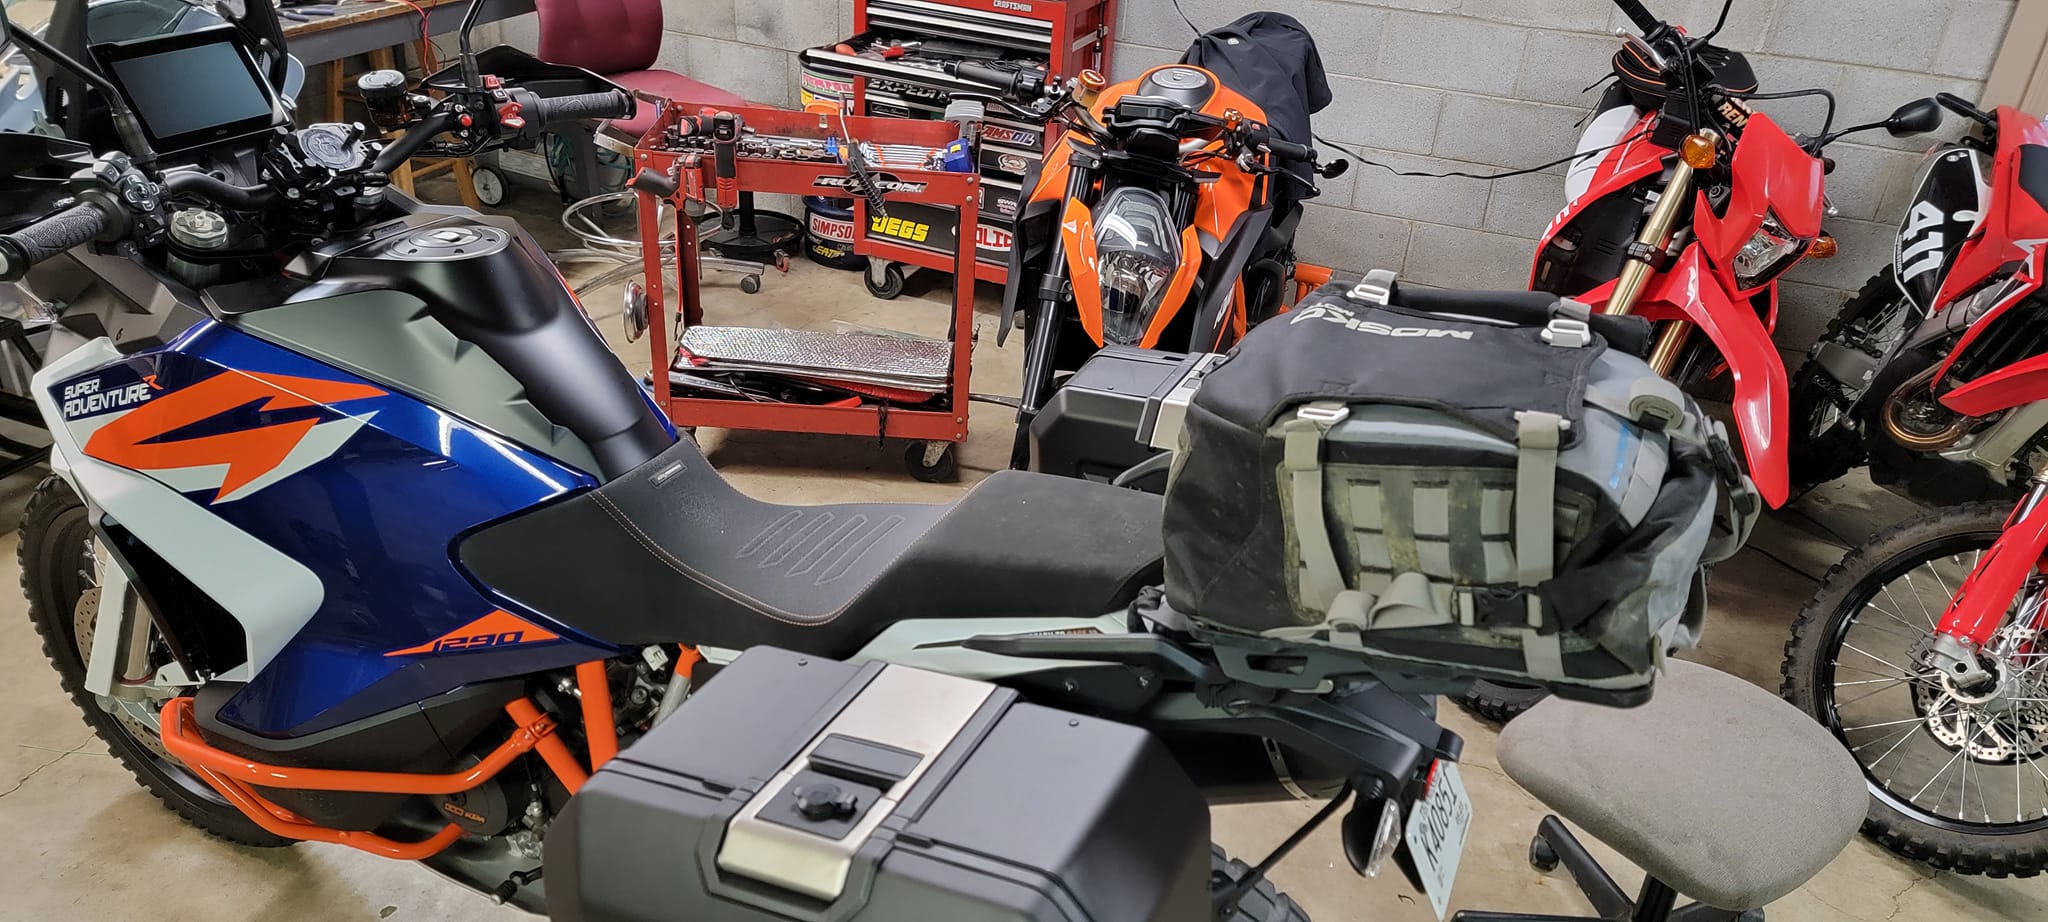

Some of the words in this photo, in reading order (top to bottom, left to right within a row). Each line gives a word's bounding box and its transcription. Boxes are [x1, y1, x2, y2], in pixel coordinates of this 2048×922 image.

[994, 0, 1032, 12] CRAFTSMAN
[1717, 101, 1748, 127] REN
[981, 123, 1035, 145] AMSOIL
[812, 217, 854, 240] SIMPSO
[872, 215, 929, 242] JEGS
[1903, 200, 1944, 284] 411
[1290, 308, 1474, 340] MOSKO
[63, 383, 152, 419] ADVENTURE
[64, 378, 100, 400] SUPER
[431, 630, 525, 653] 1290
[1420, 765, 1458, 873] K40851
